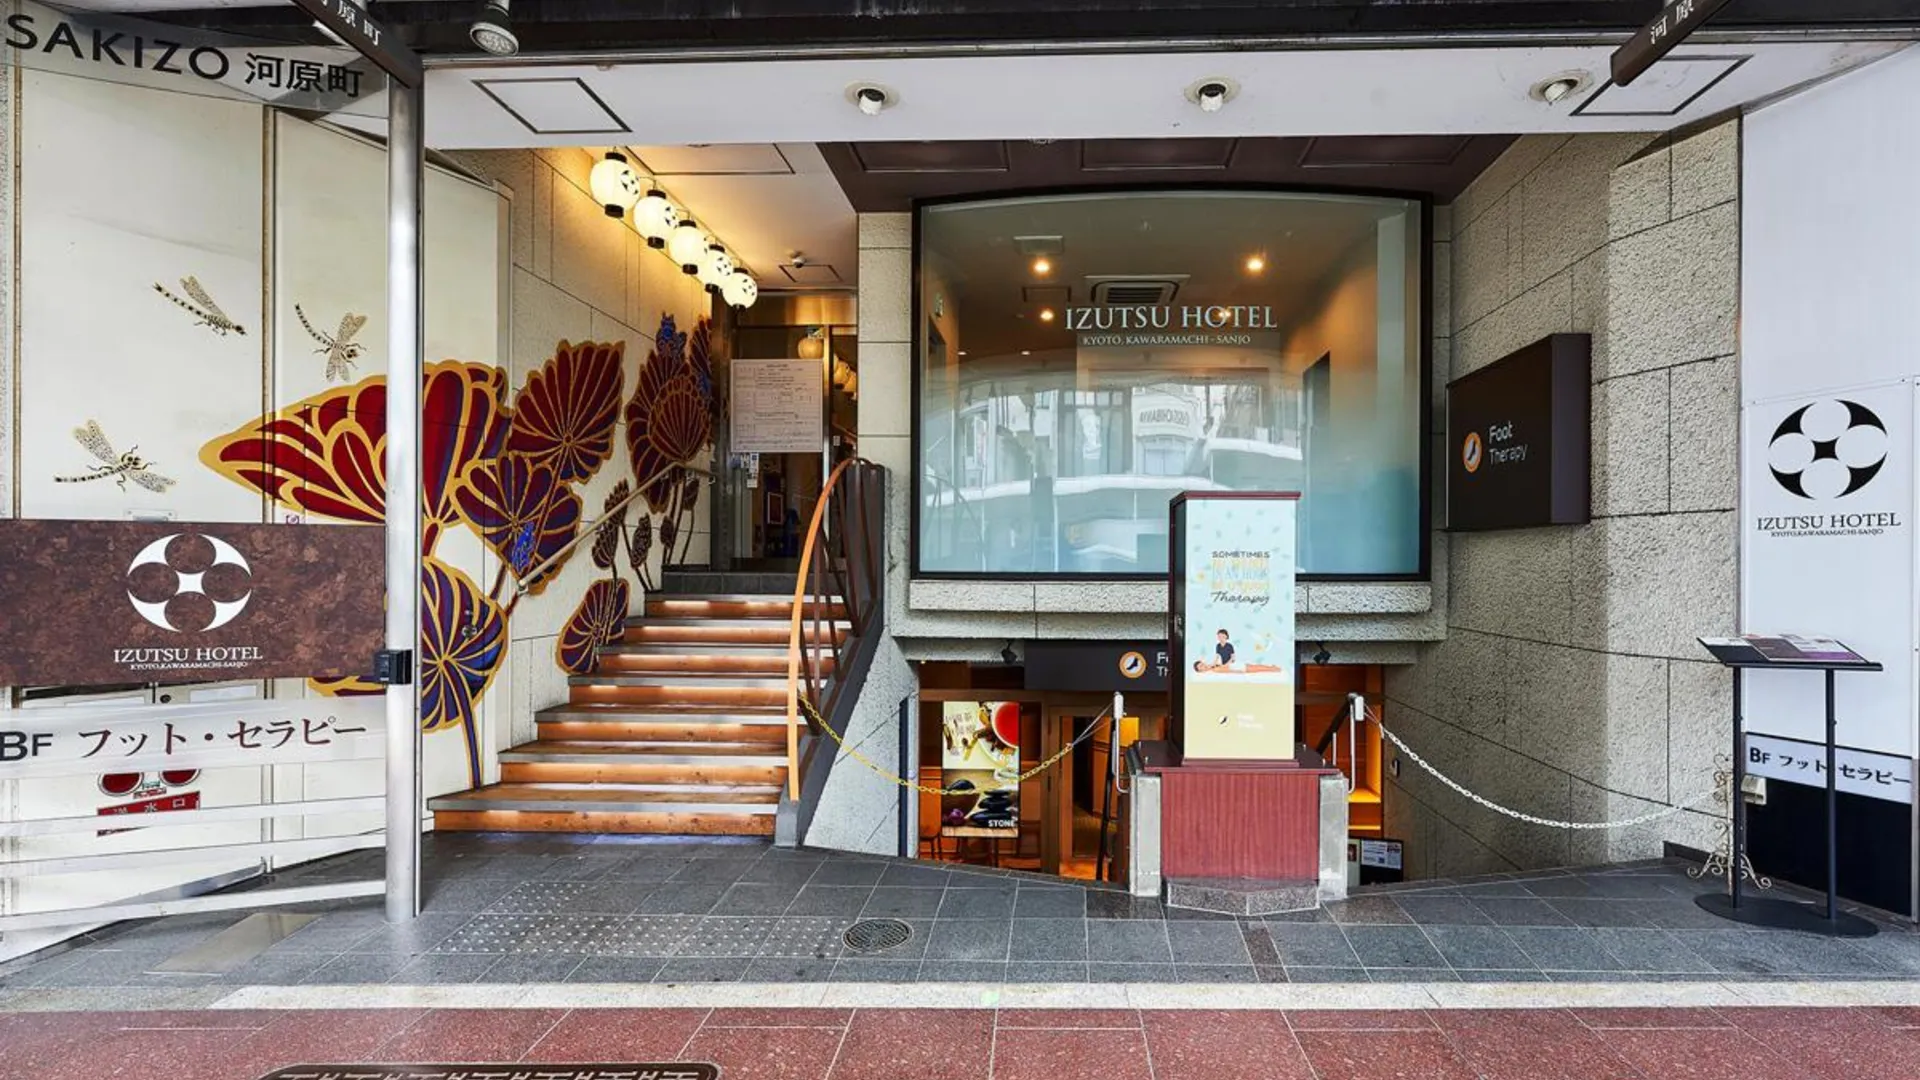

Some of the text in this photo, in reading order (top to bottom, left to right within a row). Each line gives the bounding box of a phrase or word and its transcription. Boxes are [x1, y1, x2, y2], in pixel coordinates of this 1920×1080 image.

[322, 0, 381, 45] 原町
[6, 14, 364, 98] SAKIZO 河原町
[1065, 305, 1278, 330] IZUTSU HOTEL
[1489, 420, 1513, 444] Foot
[1489, 443, 1528, 465] Therapy
[1757, 512, 1902, 531] IZUTSU HOTEL
[1212, 550, 1271, 559] SOMETIMES
[1211, 590, 1270, 606] Therapy
[114, 646, 264, 663] IZUTSU HOTEL
[0, 716, 367, 762] BF フット・セラピー
[1749, 746, 1771, 765] BF
